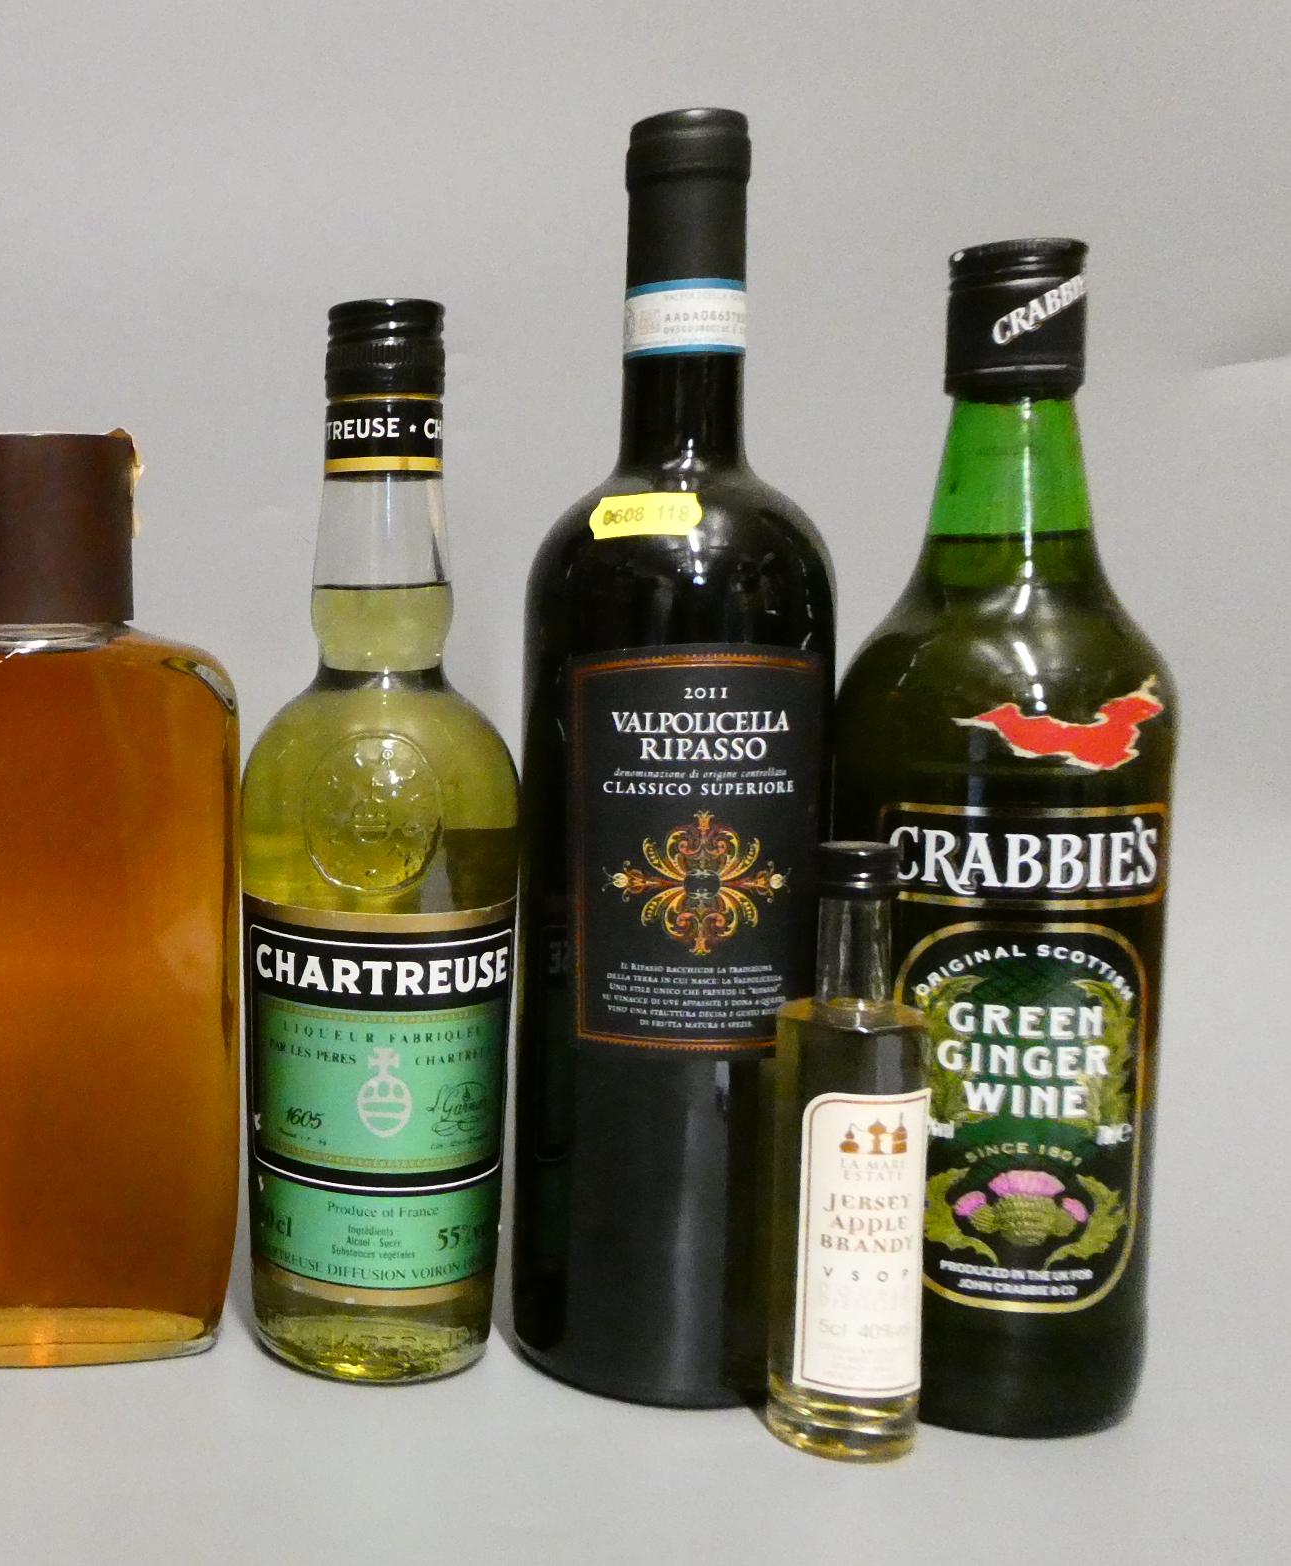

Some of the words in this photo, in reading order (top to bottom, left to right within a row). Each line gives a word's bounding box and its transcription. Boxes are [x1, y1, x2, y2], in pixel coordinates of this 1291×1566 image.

[658, 505, 690, 522] 118
[683, 687, 729, 699] 2011
[611, 710, 791, 734] VALPOLICELLA
[639, 737, 767, 760] RIPASSO
[613, 767, 685, 779] denominazione
[689, 767, 699, 779] di
[703, 768, 737, 782] origine
[602, 781, 692, 796] CLASSICO
[700, 780, 795, 796] SUPERIORE
[889, 816, 1158, 895] CRABBIE'S
[256, 943, 509, 996] CHARTREUSE
[914, 944, 1027, 997] ORIGINAL
[1036, 944, 1135, 1001] SCOTTISH
[947, 1001, 1104, 1040] GREEN
[282, 1021, 375, 1043] LIQUEUR
[937, 1039, 1110, 1080] GINGER
[962, 1081, 1089, 1119] WINE
[286, 1106, 326, 1130] 1605
[964, 1142, 1030, 1163] SINCE
[327, 1200, 377, 1218] Produce
[382, 1206, 394, 1218] of
[399, 1205, 440, 1218] France
[822, 1193, 912, 1212] JERSEY
[820, 1234, 913, 1253] BRANDY
[327, 1262, 407, 1281] DIFFUSION
